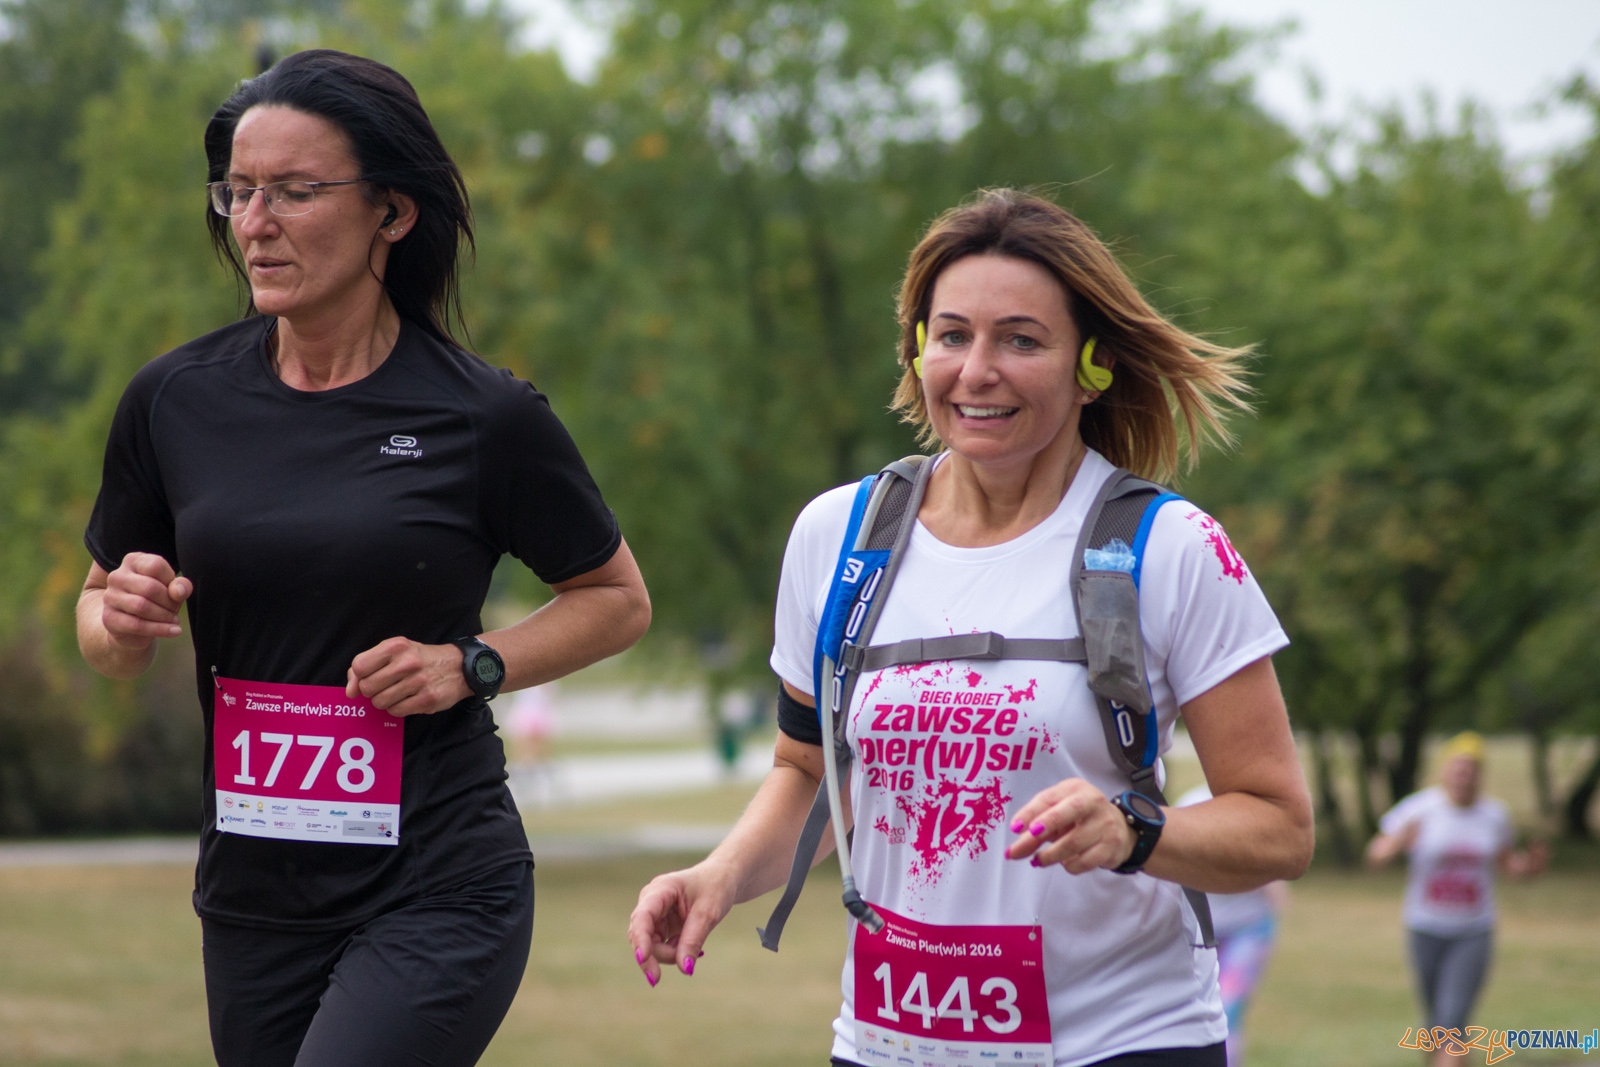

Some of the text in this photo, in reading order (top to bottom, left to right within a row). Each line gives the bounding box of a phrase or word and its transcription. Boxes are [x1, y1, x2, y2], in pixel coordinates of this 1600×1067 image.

[380, 445, 423, 458] Kalenji
[245, 698, 281, 713] Zawsze
[283, 702, 332, 717] Pier(w)si
[334, 705, 366, 718] 2016
[919, 690, 1005, 707] BIEG KOBIET
[871, 703, 1019, 737] zawsze
[231, 729, 376, 794] 1778
[868, 767, 915, 792] 2016
[929, 790, 984, 849] 15
[885, 929, 1003, 957] Zawsze Pier(w)si 2016
[873, 961, 1023, 1034] 1443
